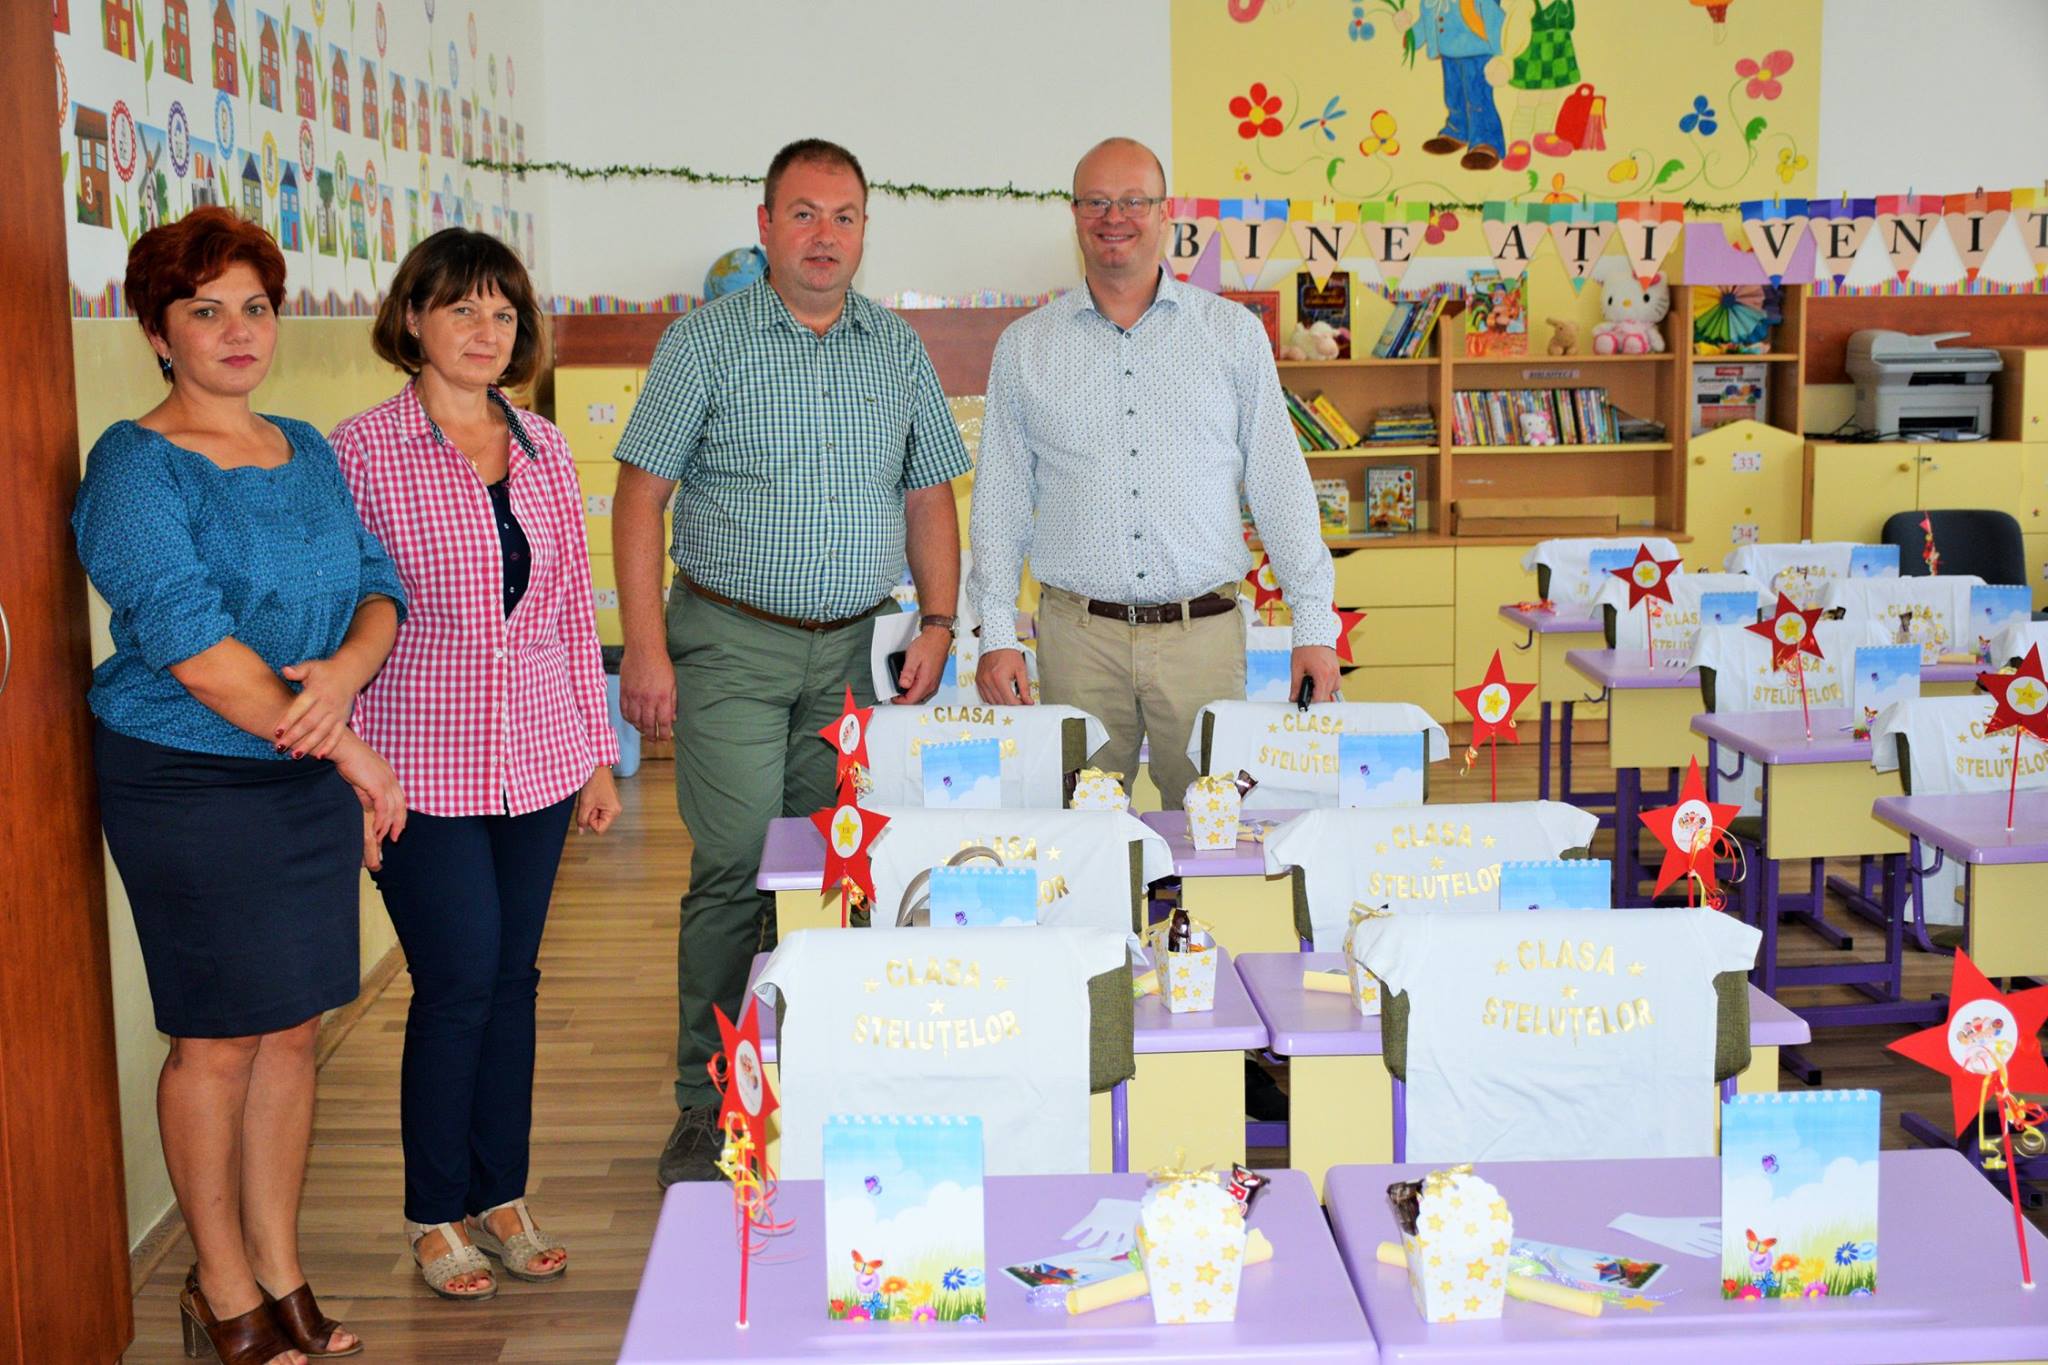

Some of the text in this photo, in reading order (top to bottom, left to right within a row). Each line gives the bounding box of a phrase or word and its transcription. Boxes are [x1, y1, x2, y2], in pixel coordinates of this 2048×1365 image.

[110, 15, 118, 41] 4
[170, 40, 177, 65] 6
[218, 57, 225, 80] 8
[85, 176, 94, 205] 3
[1171, 222, 1411, 262] BINE
[934, 705, 995, 726] CLASA
[1282, 712, 1345, 736] CLASA
[1391, 821, 1473, 849] CLASA
[1516, 938, 1615, 977] CLASA
[886, 957, 982, 991] CLASA
[853, 1010, 1023, 1060] STELUȚELOR
[1482, 995, 1657, 1048] STELUȚELOR
